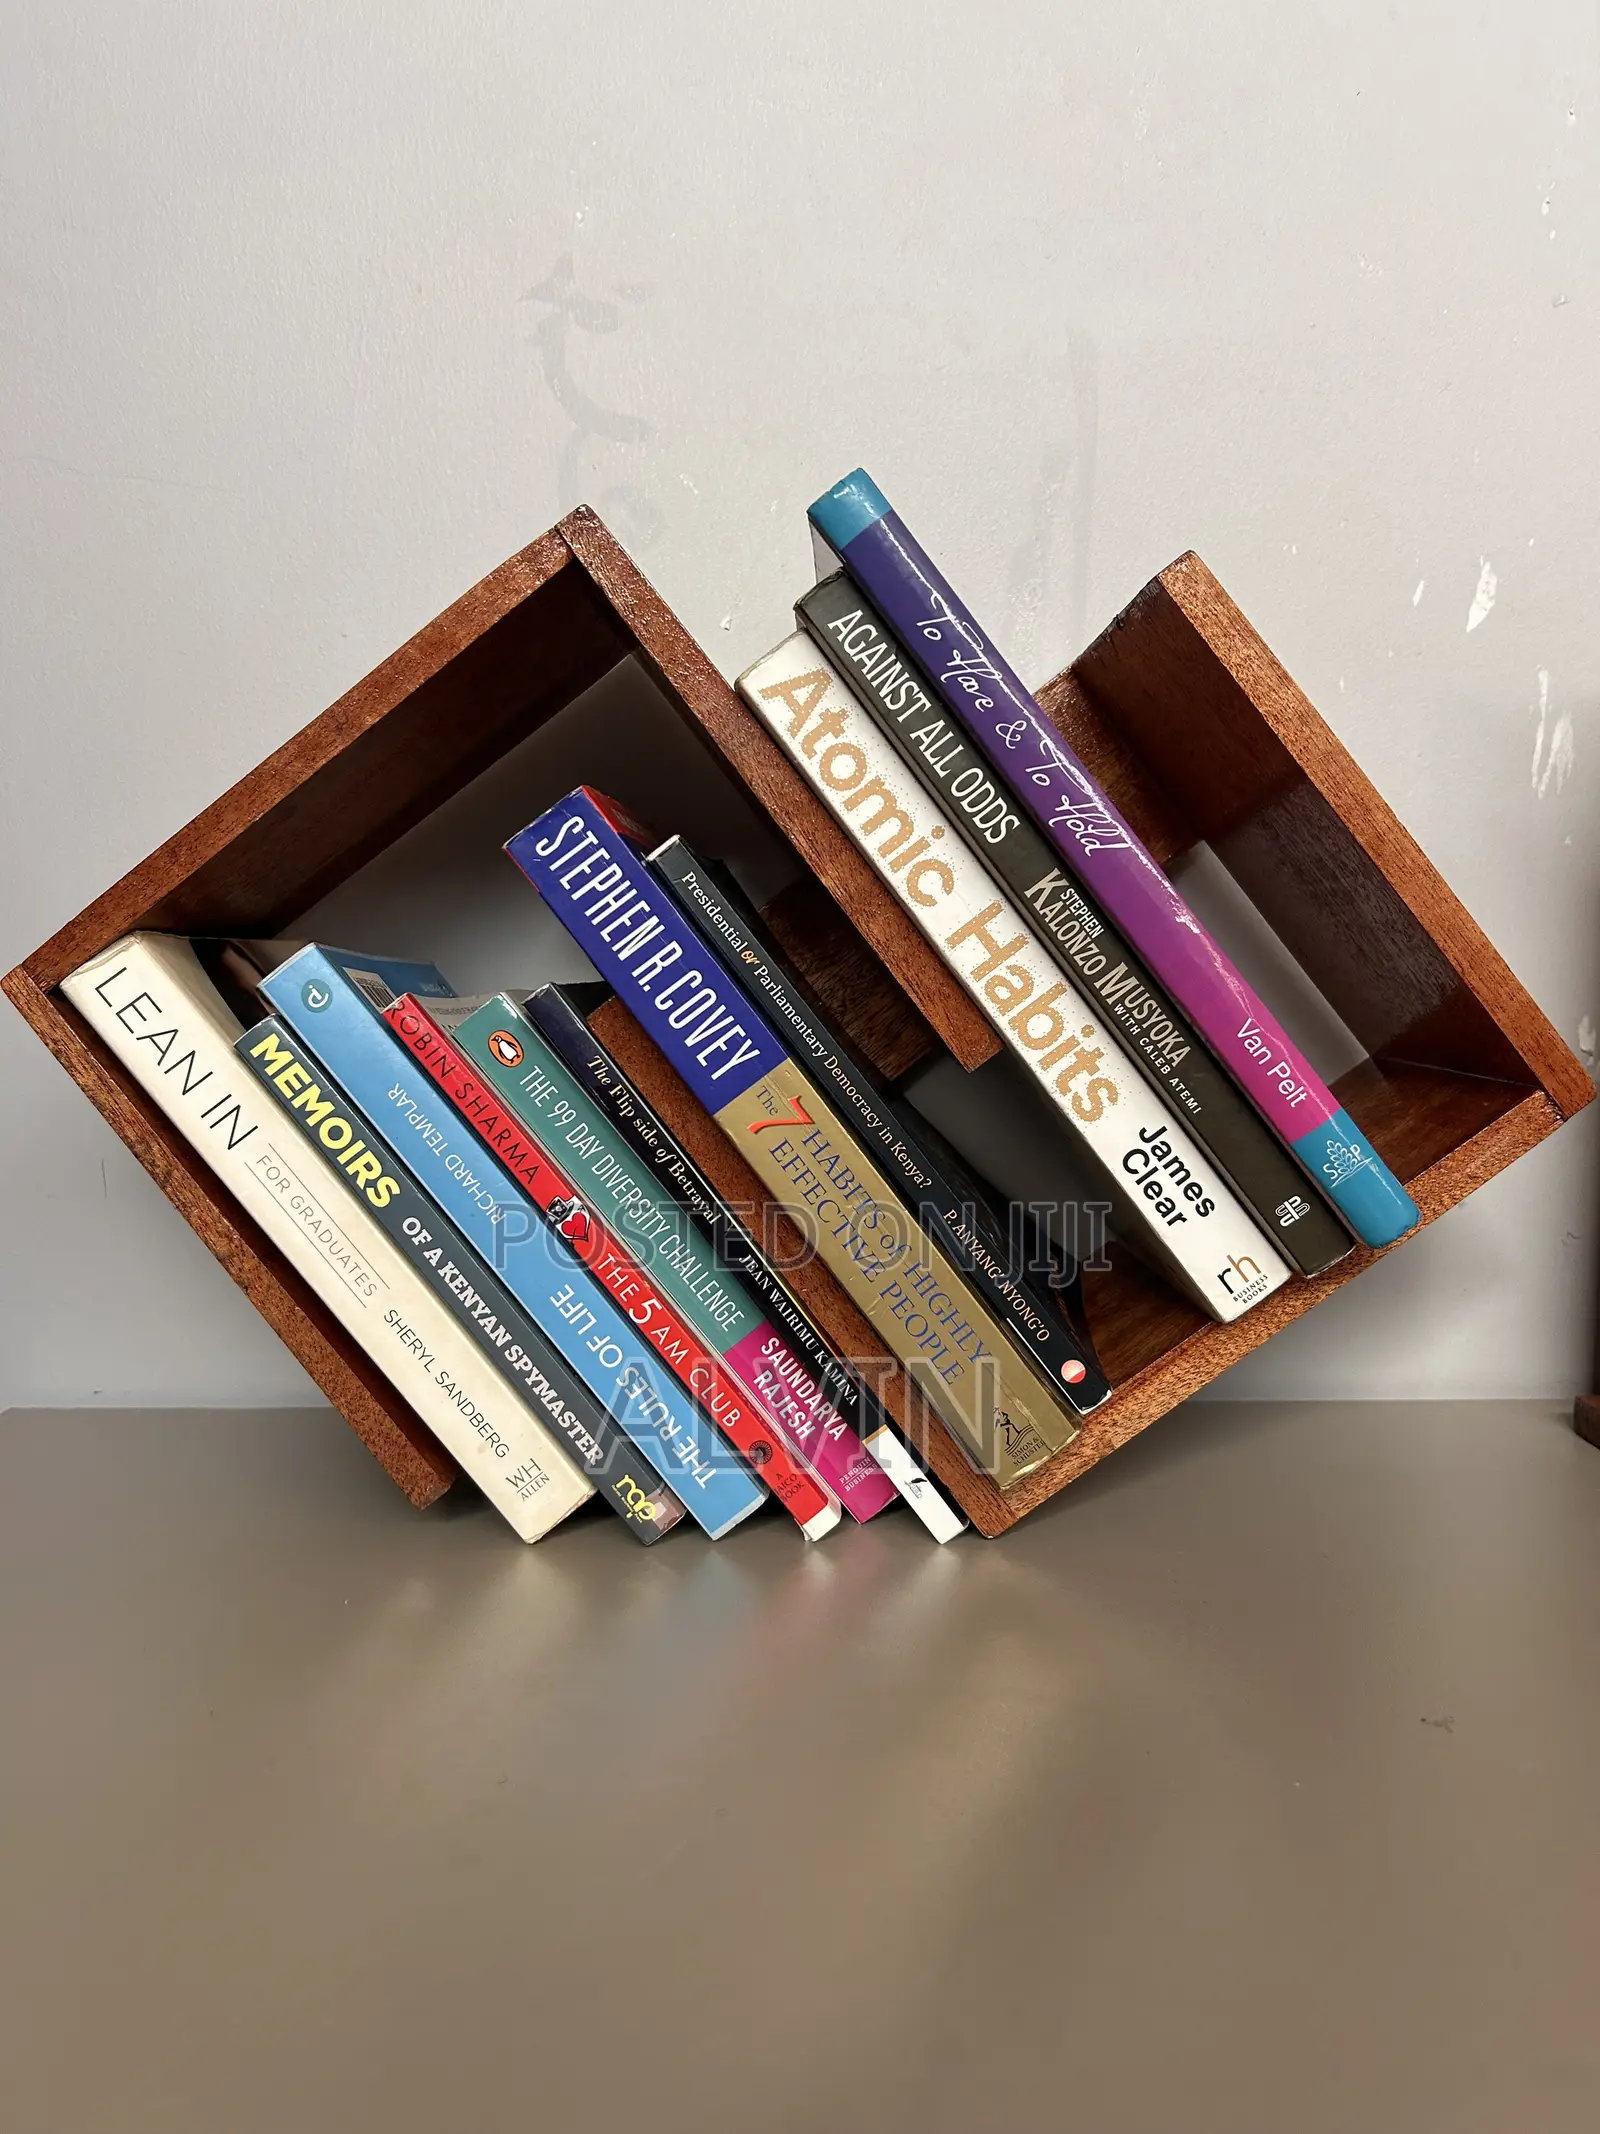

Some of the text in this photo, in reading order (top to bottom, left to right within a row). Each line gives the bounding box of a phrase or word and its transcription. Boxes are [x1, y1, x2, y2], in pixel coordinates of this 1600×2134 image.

[827, 609, 1020, 844] AGAINST ALL ODDS
[941, 650, 1002, 712] Have
[996, 721, 1027, 749] &
[1049, 795, 1131, 857] Hold
[535, 815, 760, 1081] STEPHEN R. COVEY
[758, 667, 1118, 1122] Atomic Habits
[1060, 888, 1105, 938] STEPHEN
[1024, 868, 1191, 1067] KALONZO MUSYOKA
[95, 967, 258, 1150] LEAN IN
[682, 871, 932, 1188] Presidential or Parliamentary Democracy in Kenya?
[1112, 1003, 1201, 1114] WITH CALEB ATEMI
[1236, 1017, 1308, 1108] Van Pelt
[249, 1033, 401, 1208] MEMOIRS
[386, 1001, 456, 1079] ROBIN
[455, 1082, 540, 1185] SHARMA
[587, 1055, 722, 1225] The Flip side of Betrayal
[746, 1085, 815, 1134] The 7
[388, 1082, 506, 1224] RICHARD TEMPLAR
[519, 1065, 745, 1332] THE 99 DAY DIVERSITY CHALLENGE
[1123, 1148, 1188, 1227] Clear
[1139, 1126, 1215, 1217] James
[256, 1155, 377, 1298] FOR GRADUATES
[768, 1137, 965, 1386] EFFECTIVE PEOPLE
[801, 1128, 993, 1365] HABITS of HIGHLY
[943, 1209, 956, 1225] P.
[998, 1279, 1050, 1342] NYONG'O
[1217, 1254, 1262, 1294] rh
[402, 1217, 604, 1465] OF A KENYAN SPYMASTER
[550, 1284, 597, 1335] LIFE
[598, 1253, 640, 1301] THE
[629, 1301, 662, 1325] 5
[689, 1368, 741, 1428] CLUB
[739, 1254, 858, 1407] JEAN WAIRIMU KAMINA
[1233, 1273, 1269, 1302] BUSINESS
[1242, 1284, 1268, 1305] BOOKS
[384, 1309, 510, 1458] SHERYL SANDBERG
[586, 1335, 623, 1368] OF
[616, 1367, 683, 1442] RULES
[753, 1369, 816, 1440] RAJESH
[761, 1337, 848, 1442] SAUNDARYA
[505, 1458, 542, 1489] WH
[520, 1473, 550, 1501] ALLEN
[672, 1436, 718, 1490] THE
[773, 1473, 797, 1496] AICO
[839, 1456, 871, 1484] PENGUIN
[844, 1463, 878, 1492] BUSINESS
[1011, 1440, 1034, 1459] SIMON
